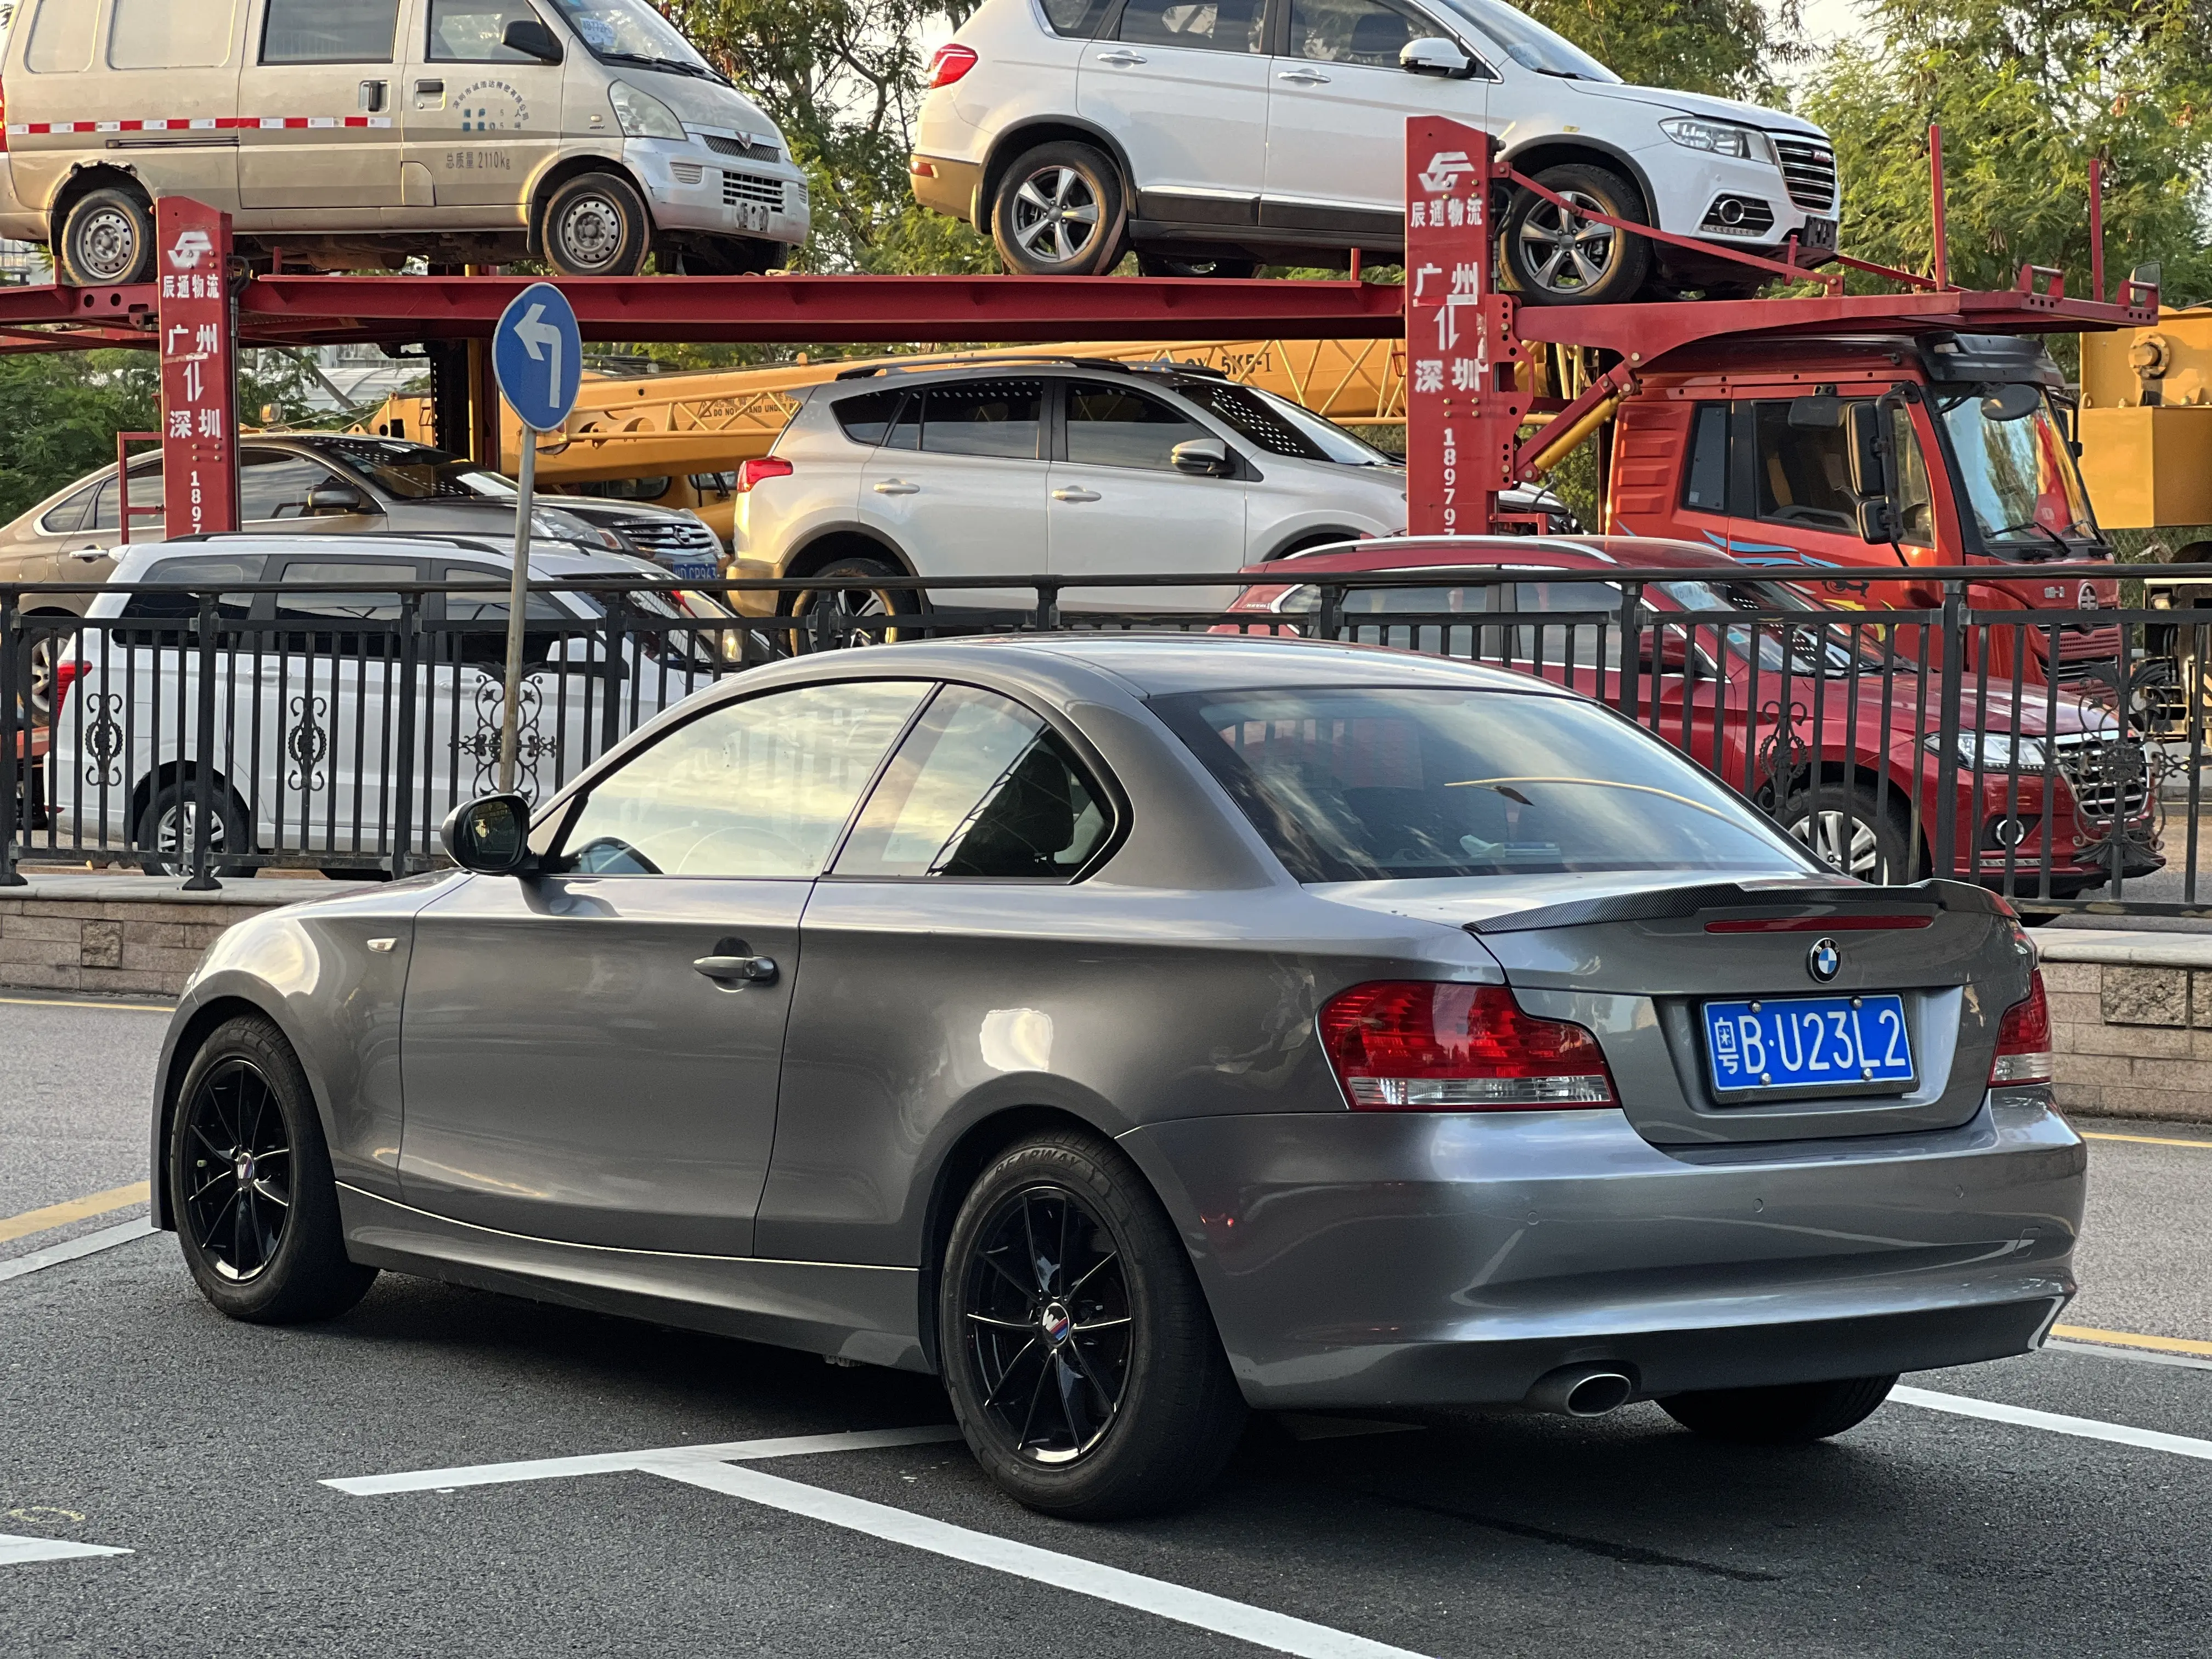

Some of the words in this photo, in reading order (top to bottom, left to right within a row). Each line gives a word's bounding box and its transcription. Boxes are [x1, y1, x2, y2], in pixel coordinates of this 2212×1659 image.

[515, 109, 521, 117] 人
[446, 151, 474, 169] 总质量
[478, 151, 510, 170] 2110kg
[1410, 198, 1483, 228] 辰通物流
[162, 274, 219, 298] 辰通物流
[1414, 262, 1479, 297] 广州
[167, 323, 218, 354] 广州
[1415, 357, 1481, 393] 深圳
[170, 408, 221, 439] 深圳
[725, 408, 737, 416] NO
